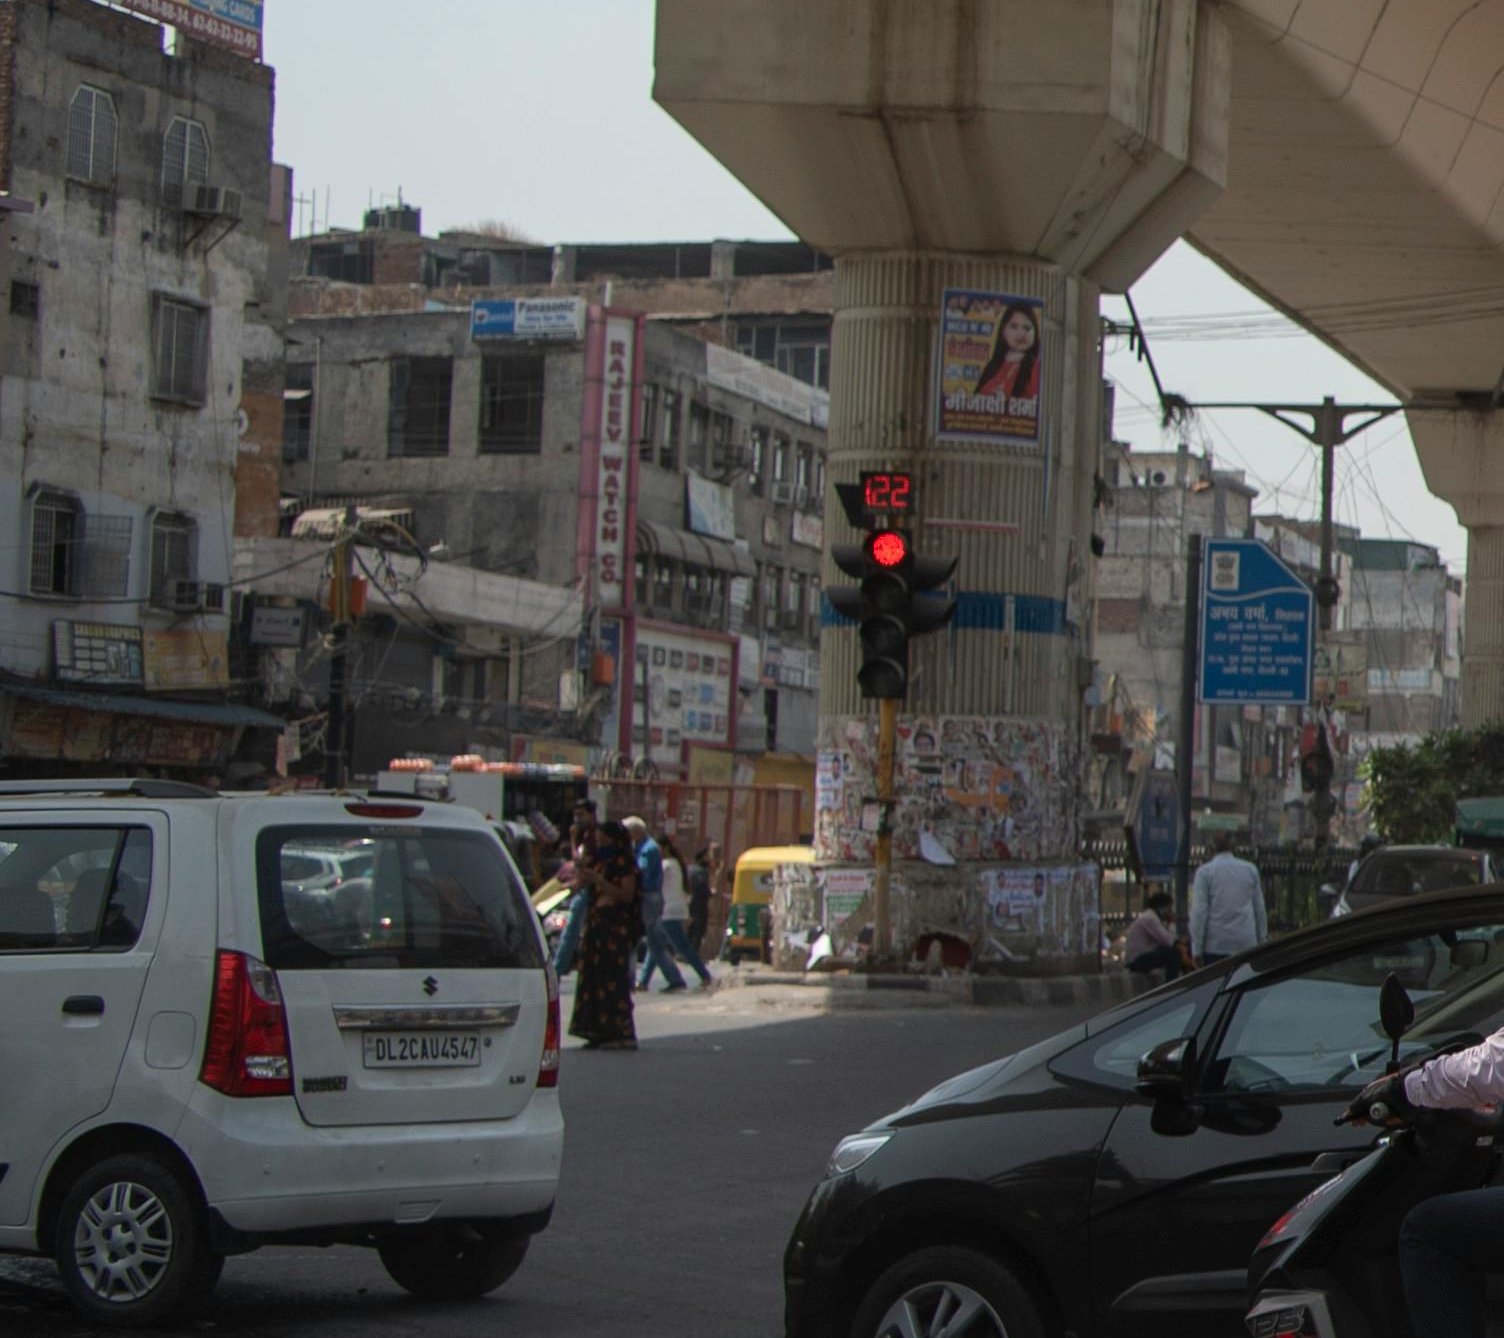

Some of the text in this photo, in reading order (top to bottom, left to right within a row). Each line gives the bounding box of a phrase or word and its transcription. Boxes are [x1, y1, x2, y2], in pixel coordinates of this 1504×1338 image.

[518, 299, 576, 314] Panasonic
[606, 341, 627, 444] RAJEEV
[601, 454, 623, 541] WATCH
[376, 1036, 478, 1061] DL2CAU4547
